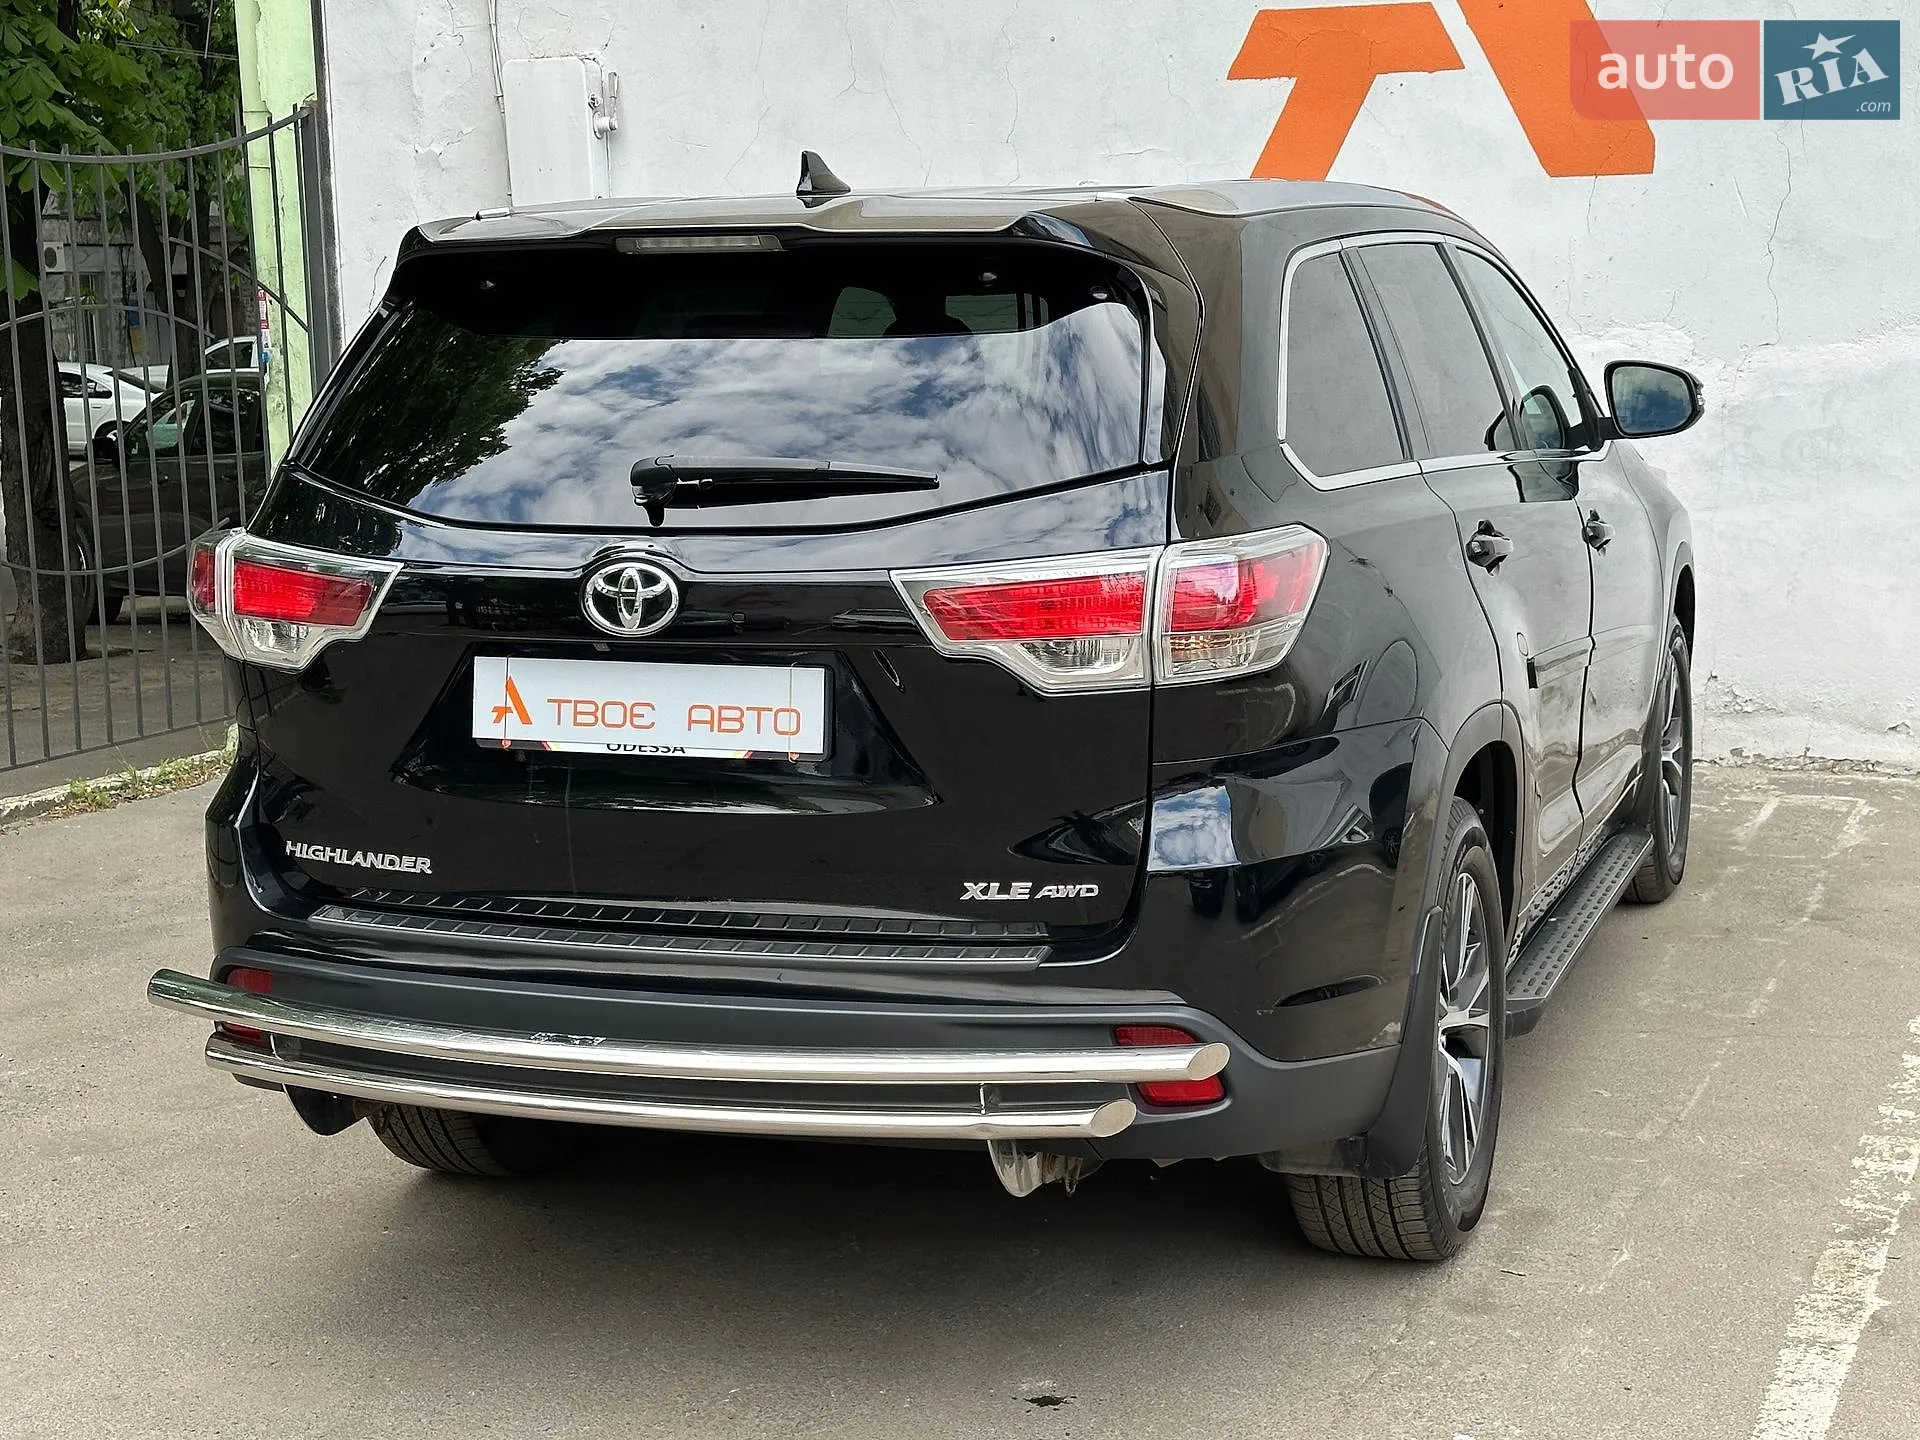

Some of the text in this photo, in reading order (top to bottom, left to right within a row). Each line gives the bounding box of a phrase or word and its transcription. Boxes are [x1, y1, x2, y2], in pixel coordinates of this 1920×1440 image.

[547, 698, 656, 730] ТВОЄ
[687, 704, 801, 736] АВТО
[285, 840, 433, 875] HIGHLANDER
[959, 882, 1100, 901] XLE AWD
